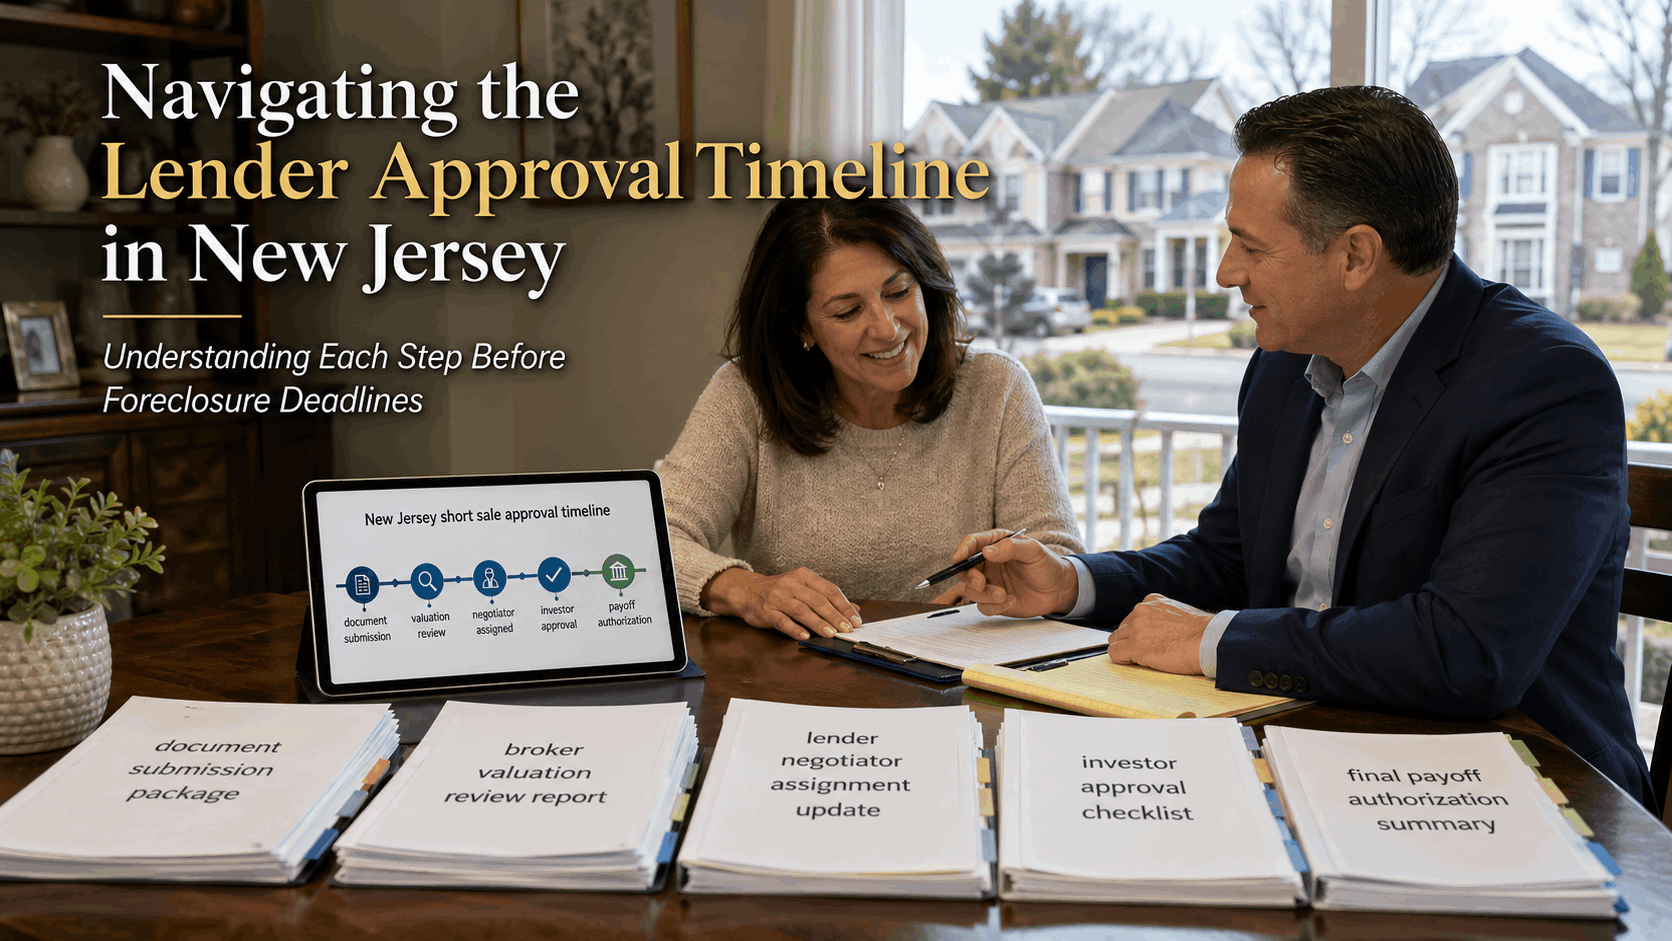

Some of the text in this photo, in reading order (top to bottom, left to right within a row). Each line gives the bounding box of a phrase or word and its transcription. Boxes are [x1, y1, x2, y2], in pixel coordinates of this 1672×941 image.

[364, 503, 611, 527] New Jersey short sale approval timeline
[540, 605, 575, 615] investor
[608, 599, 636, 614] payoff
[343, 615, 388, 628] document
[410, 612, 450, 624] valuation
[472, 608, 515, 622] negotiator
[597, 614, 653, 628] authorization
[417, 627, 446, 639] review
[476, 622, 514, 637] assigned
[541, 618, 578, 633] approval
[343, 631, 392, 644] submission
[807, 731, 879, 745] lender
[155, 739, 282, 753] document
[504, 742, 585, 756] broker
[128, 761, 274, 777] submission
[781, 753, 903, 771] negotiator
[1082, 755, 1178, 770] investor
[478, 765, 592, 780] valuation
[1346, 768, 1482, 786] final payoff
[770, 777, 911, 795] assignment
[1081, 780, 1187, 798] approval
[125, 785, 240, 804] package
[444, 789, 608, 807] review report
[1348, 791, 1509, 806] authorization
[796, 802, 881, 821] update
[1082, 804, 1194, 821] checklist
[1376, 819, 1495, 835] summary
